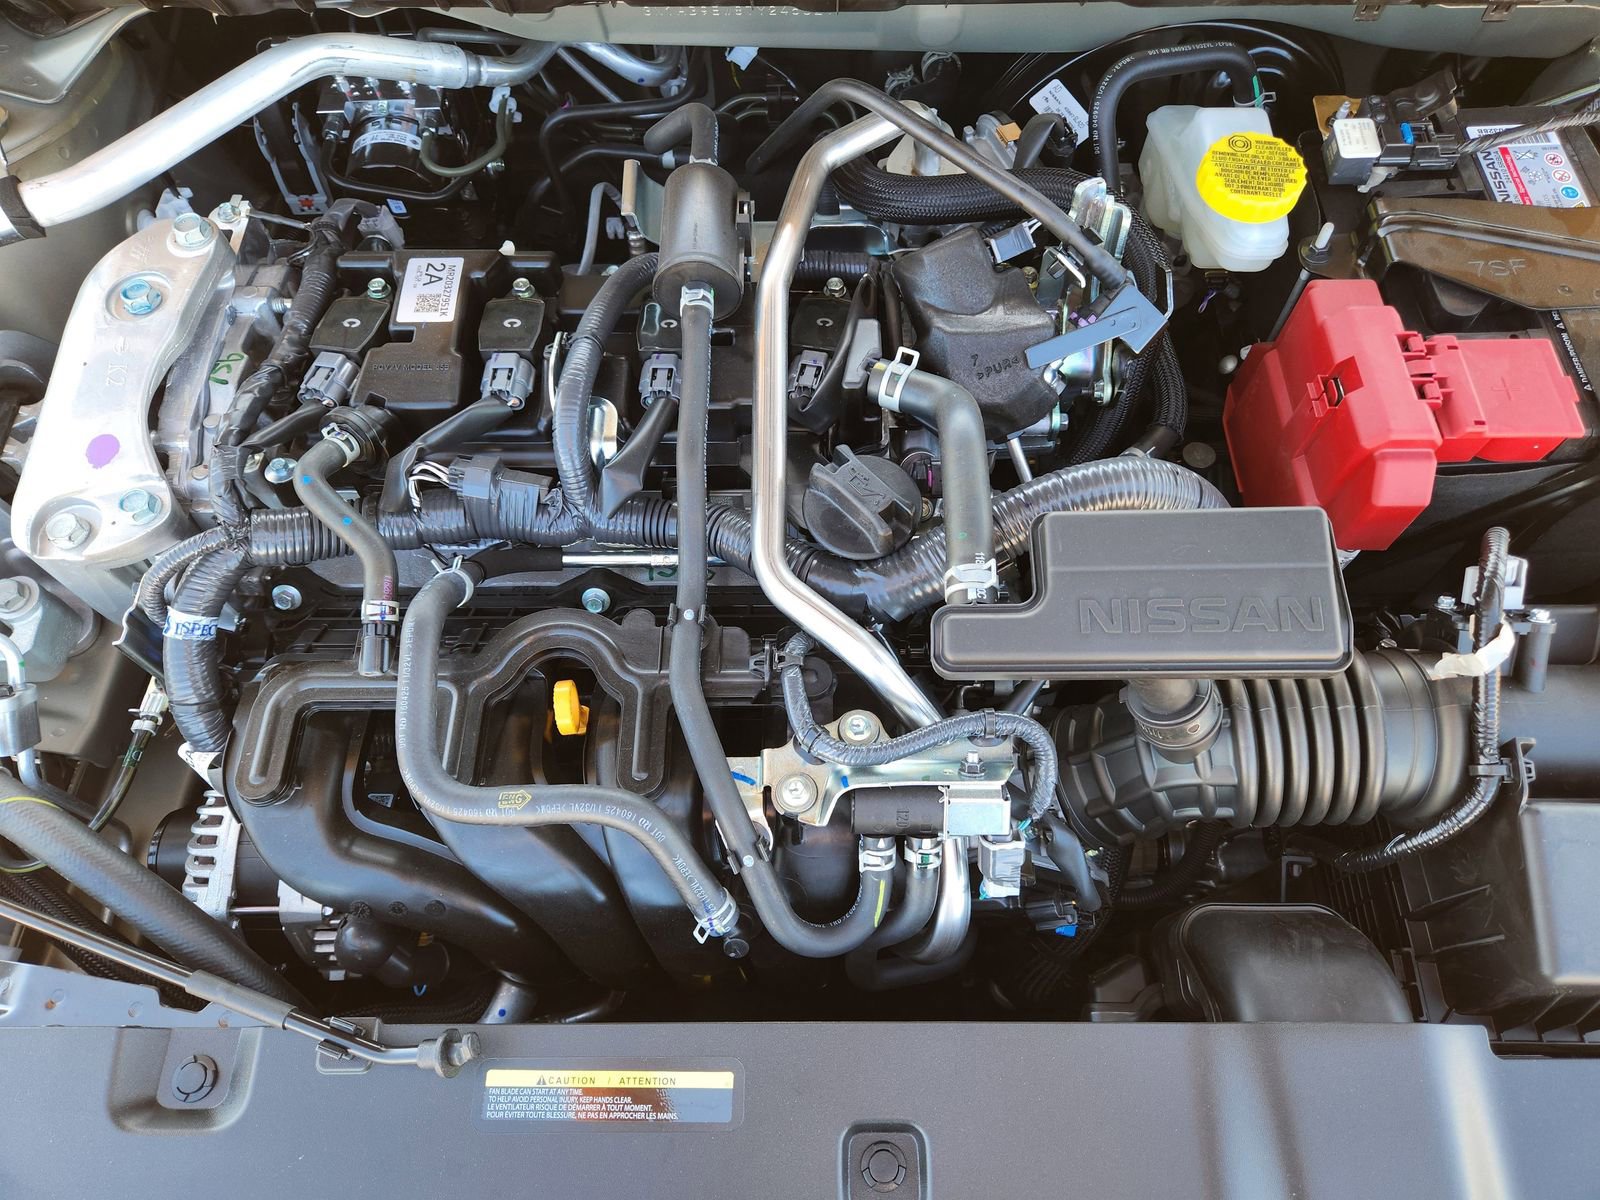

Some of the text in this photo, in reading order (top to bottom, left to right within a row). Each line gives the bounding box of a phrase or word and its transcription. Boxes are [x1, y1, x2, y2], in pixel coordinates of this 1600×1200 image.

[422, 262, 446, 286] 2A
[1079, 596, 1325, 634] NISSAN
[548, 1076, 596, 1085] CAUTION
[619, 1077, 676, 1086] ATTENTION
